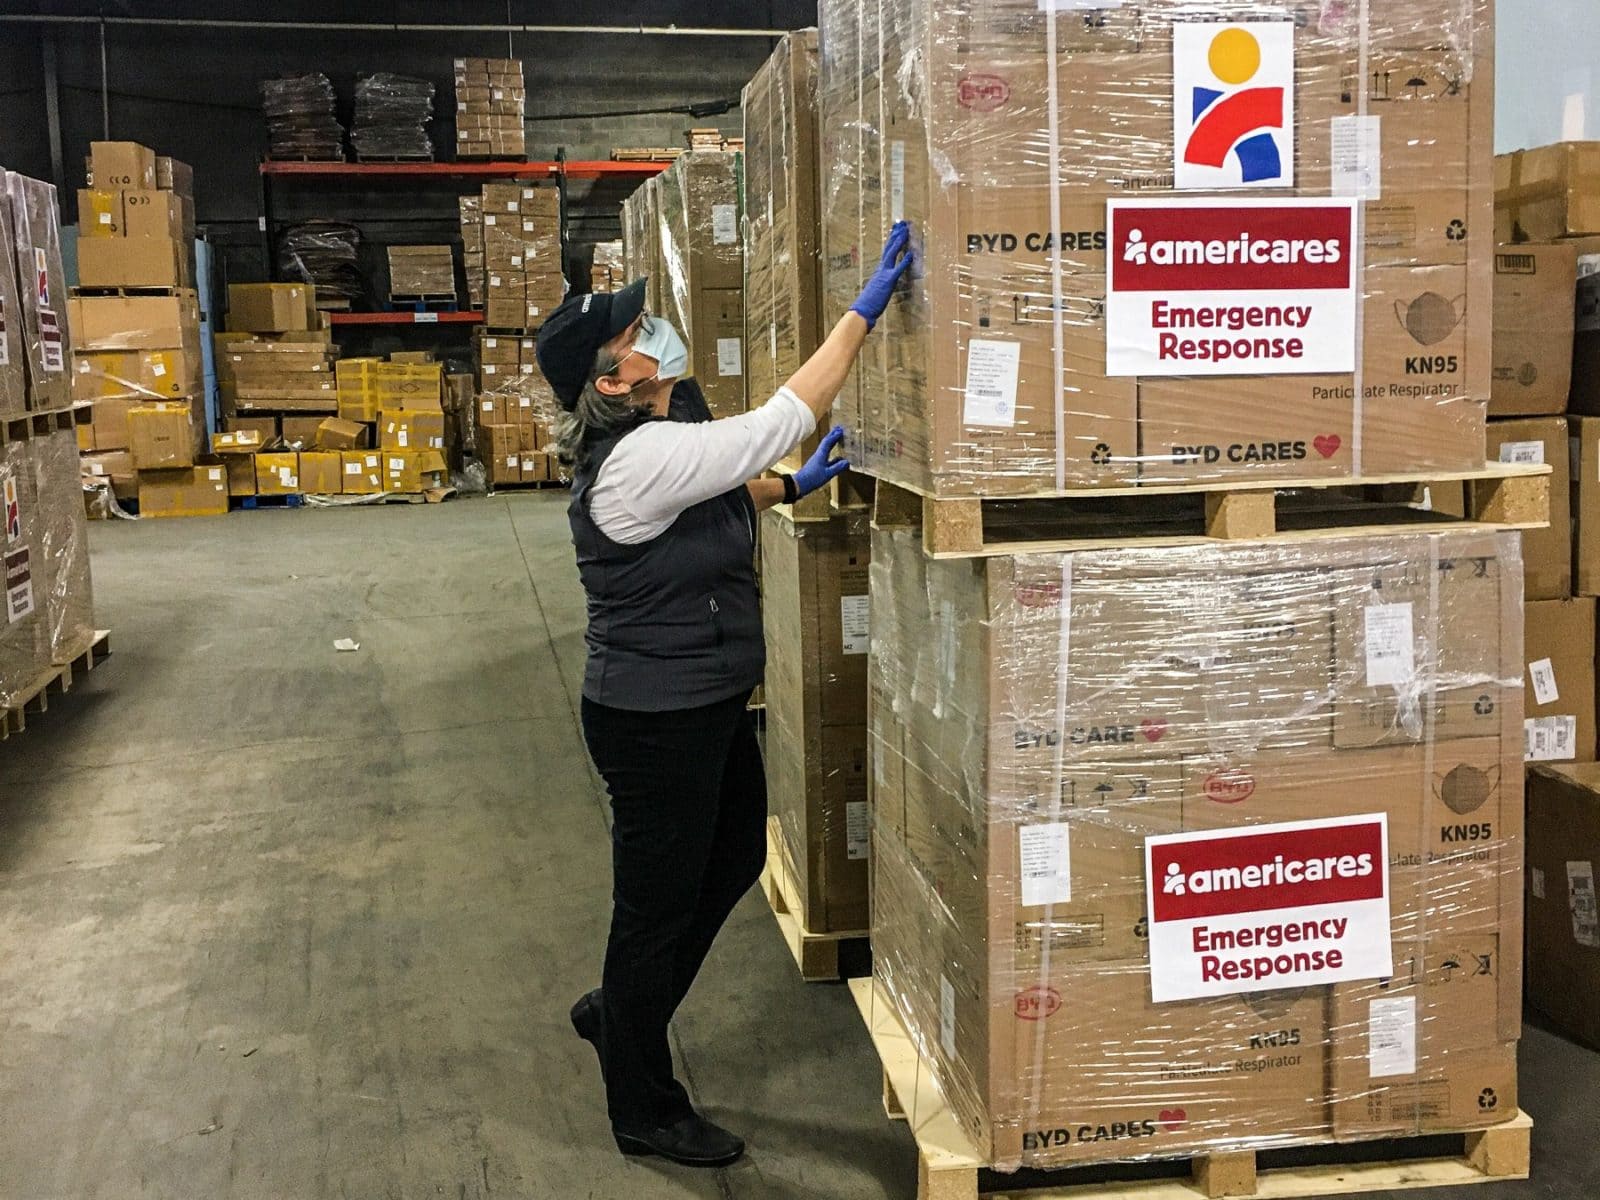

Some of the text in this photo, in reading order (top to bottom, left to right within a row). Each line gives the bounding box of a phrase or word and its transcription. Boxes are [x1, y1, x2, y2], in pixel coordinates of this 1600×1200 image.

[966, 231, 1107, 253] BYD CARES
[1150, 232, 1340, 265] americares
[1152, 300, 1312, 331] Emergency
[1159, 332, 1303, 363] Response
[1405, 356, 1458, 374] KN95
[1389, 381, 1459, 399] Respirator
[1172, 440, 1307, 465] BYD CARES
[1441, 823, 1492, 842] KN95
[1188, 853, 1373, 894] americares
[1192, 918, 1348, 952] Emergency
[1201, 949, 1343, 982] Response
[1250, 1028, 1300, 1049] KN95
[1235, 1055, 1302, 1073] Respirator
[1023, 1119, 1156, 1150] BYD CARES
